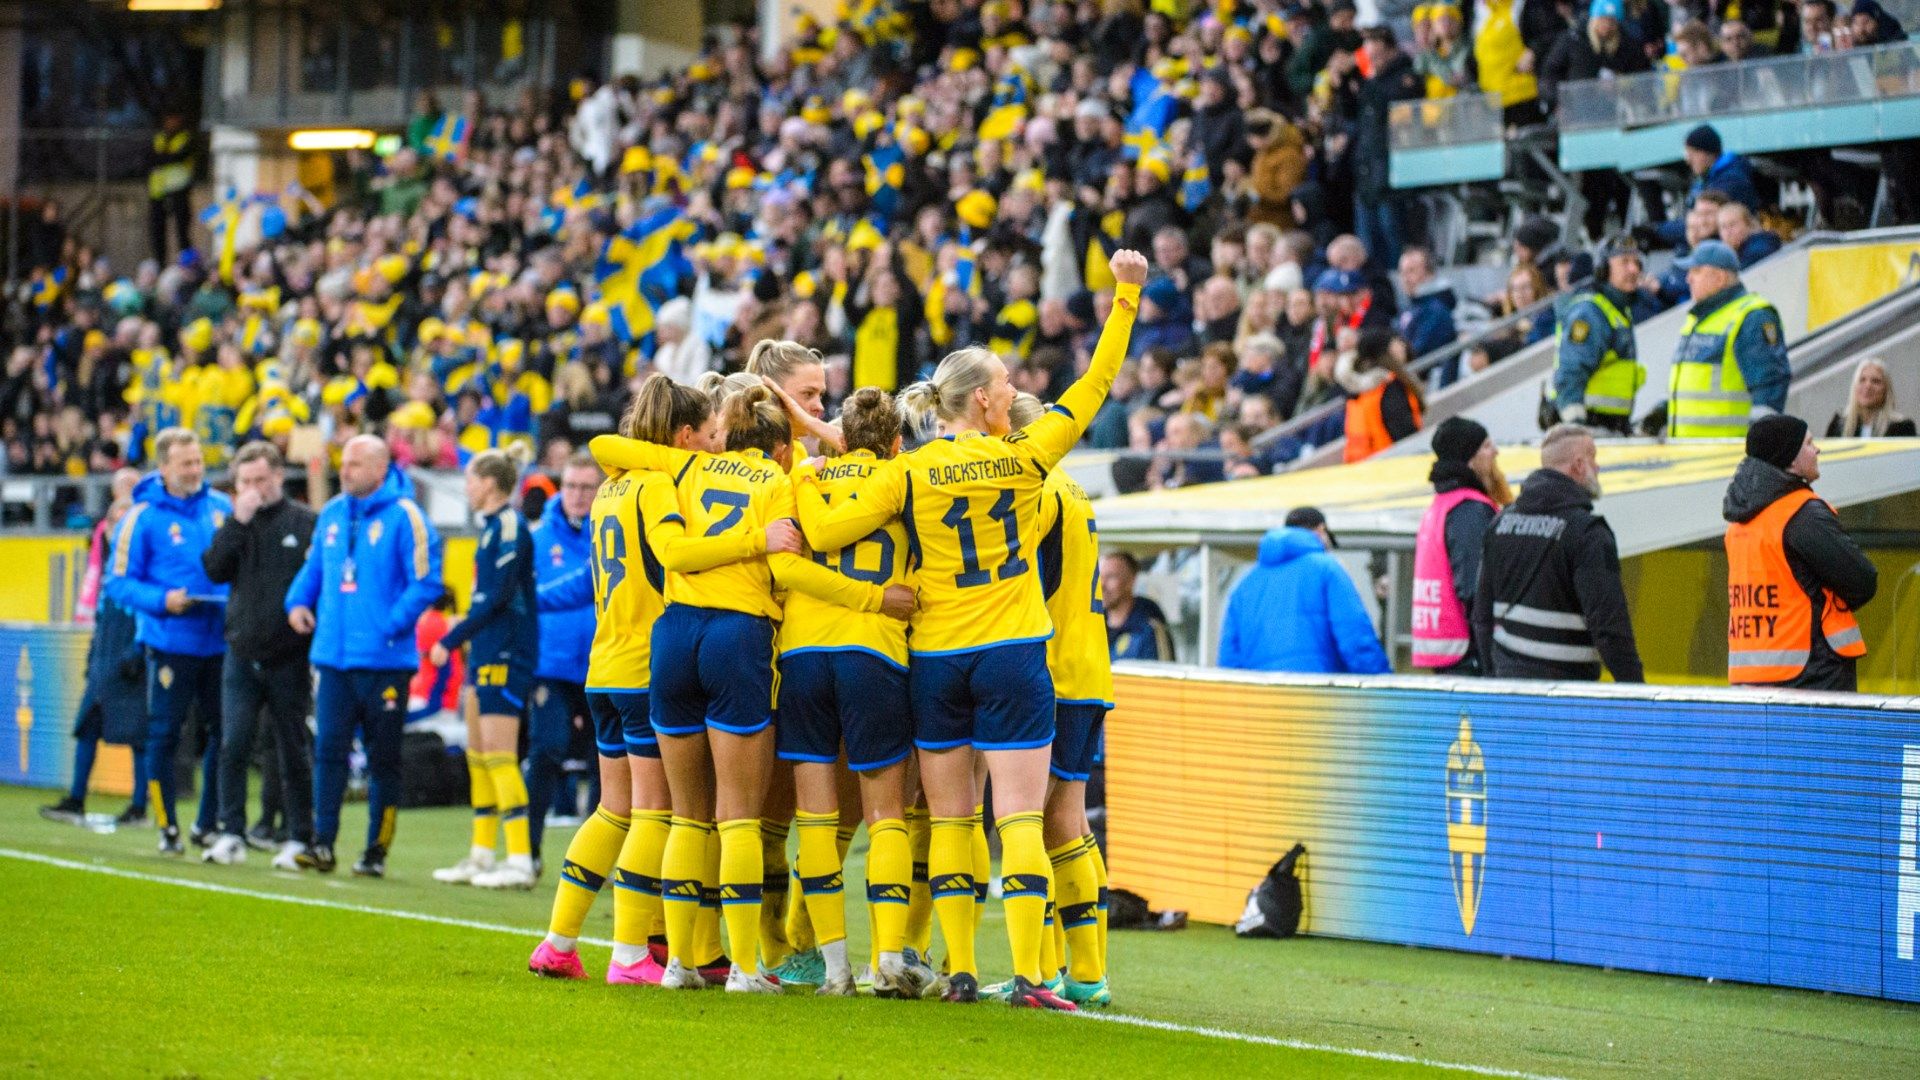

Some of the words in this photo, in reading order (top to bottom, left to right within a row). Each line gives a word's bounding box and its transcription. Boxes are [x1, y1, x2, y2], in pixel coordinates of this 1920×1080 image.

[702, 457, 774, 484] JANOGY
[929, 457, 1023, 486] BLACKSTENIUS
[941, 488, 1030, 588] 11
